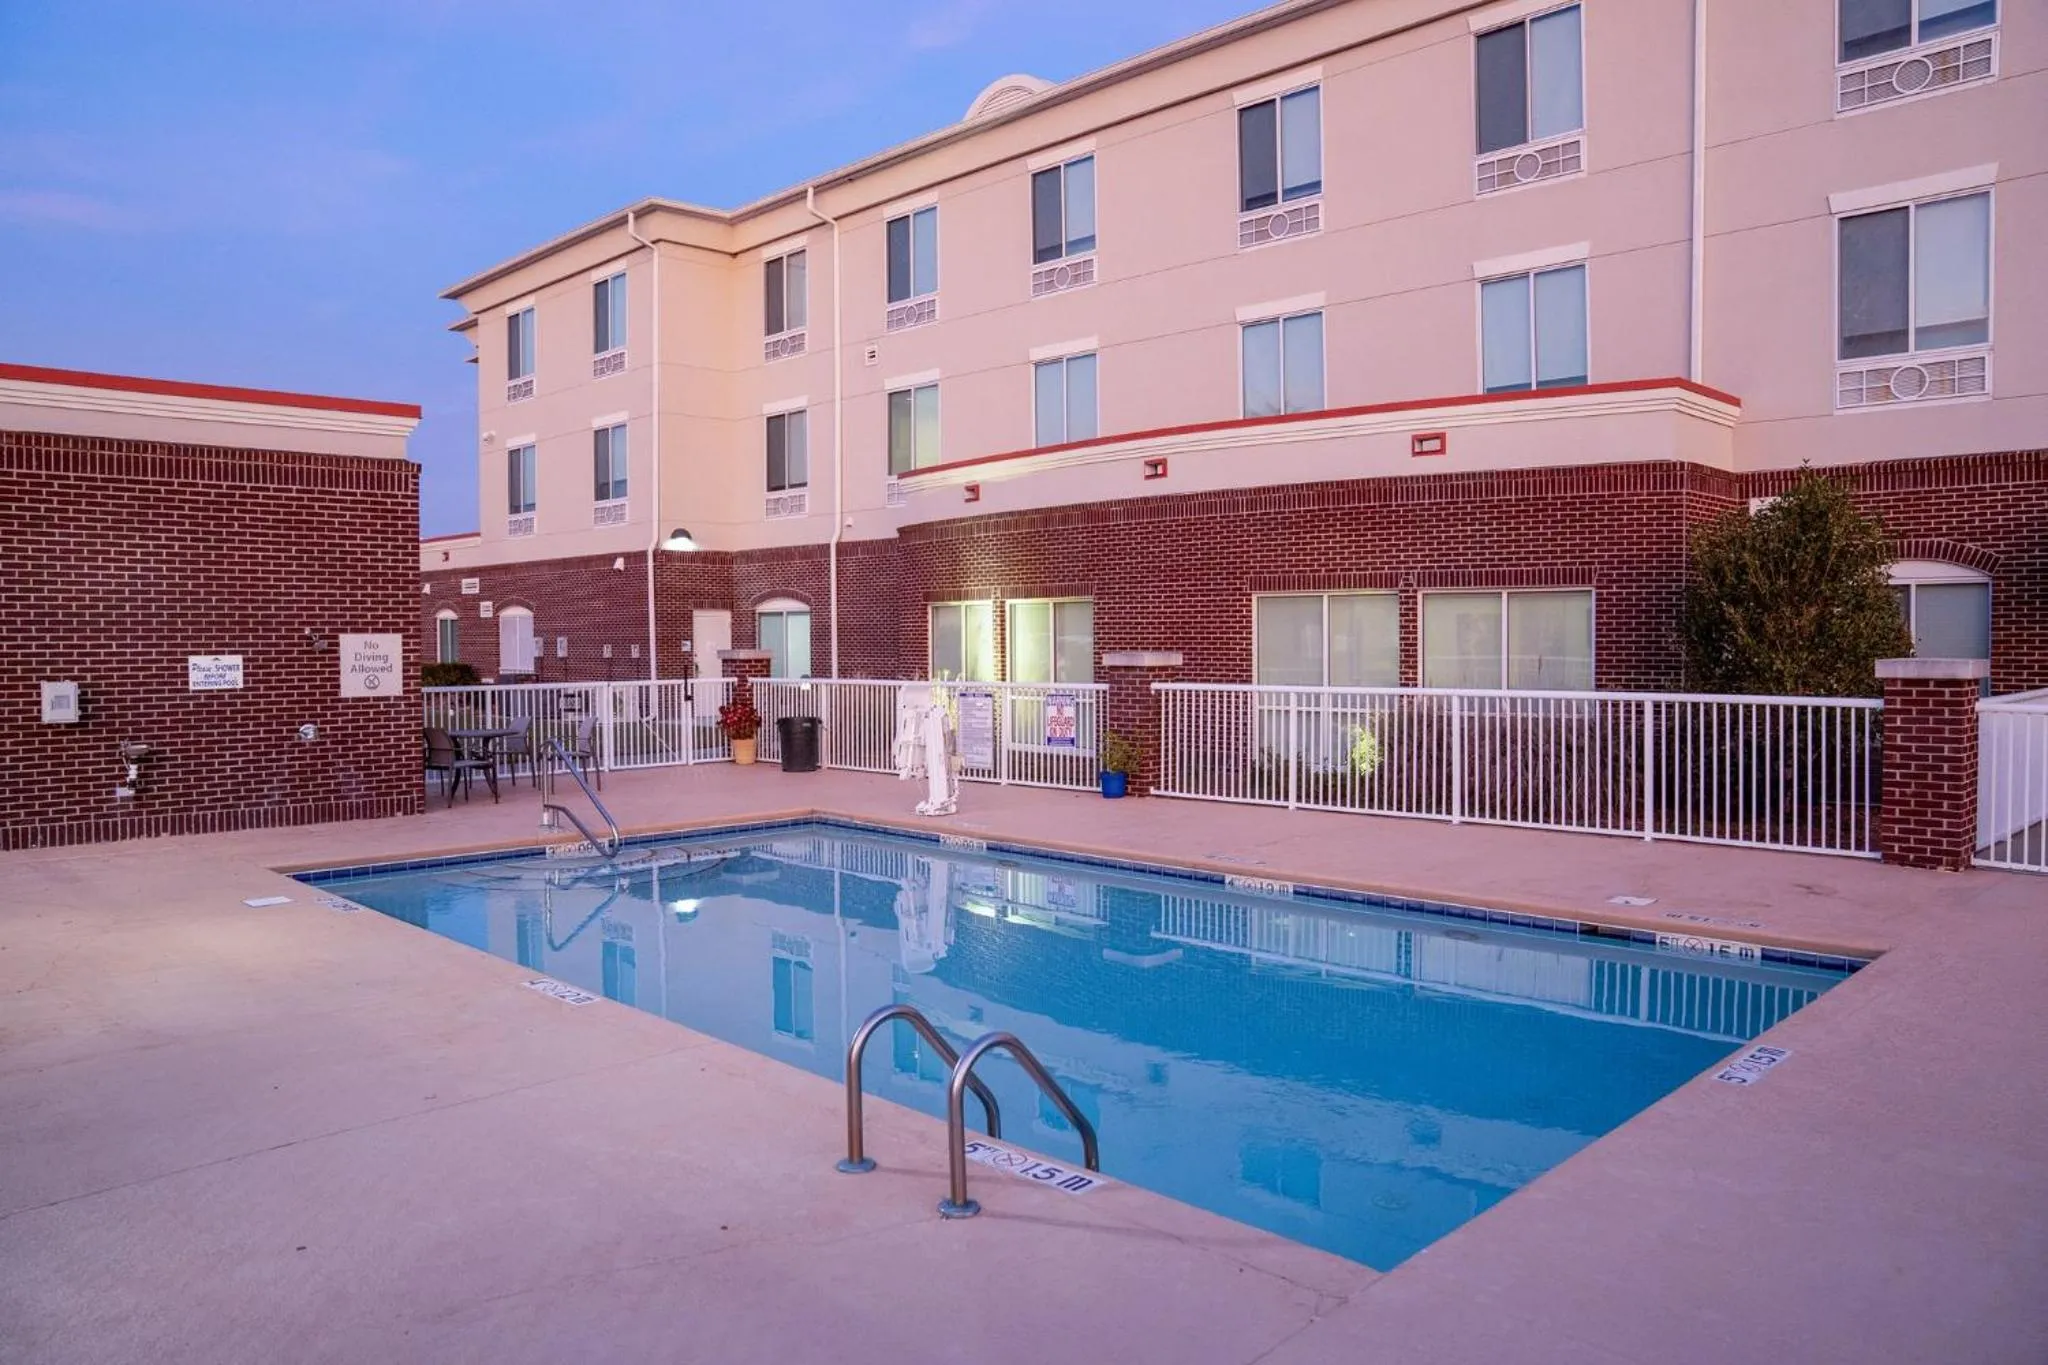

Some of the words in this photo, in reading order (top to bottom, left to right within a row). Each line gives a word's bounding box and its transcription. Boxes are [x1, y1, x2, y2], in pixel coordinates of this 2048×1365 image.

[363, 640, 379, 650] No
[354, 652, 389, 664] Diving
[215, 664, 240, 672] SHOWER
[350, 663, 393, 673] Allowed
[965, 1142, 985, 1154] 5
